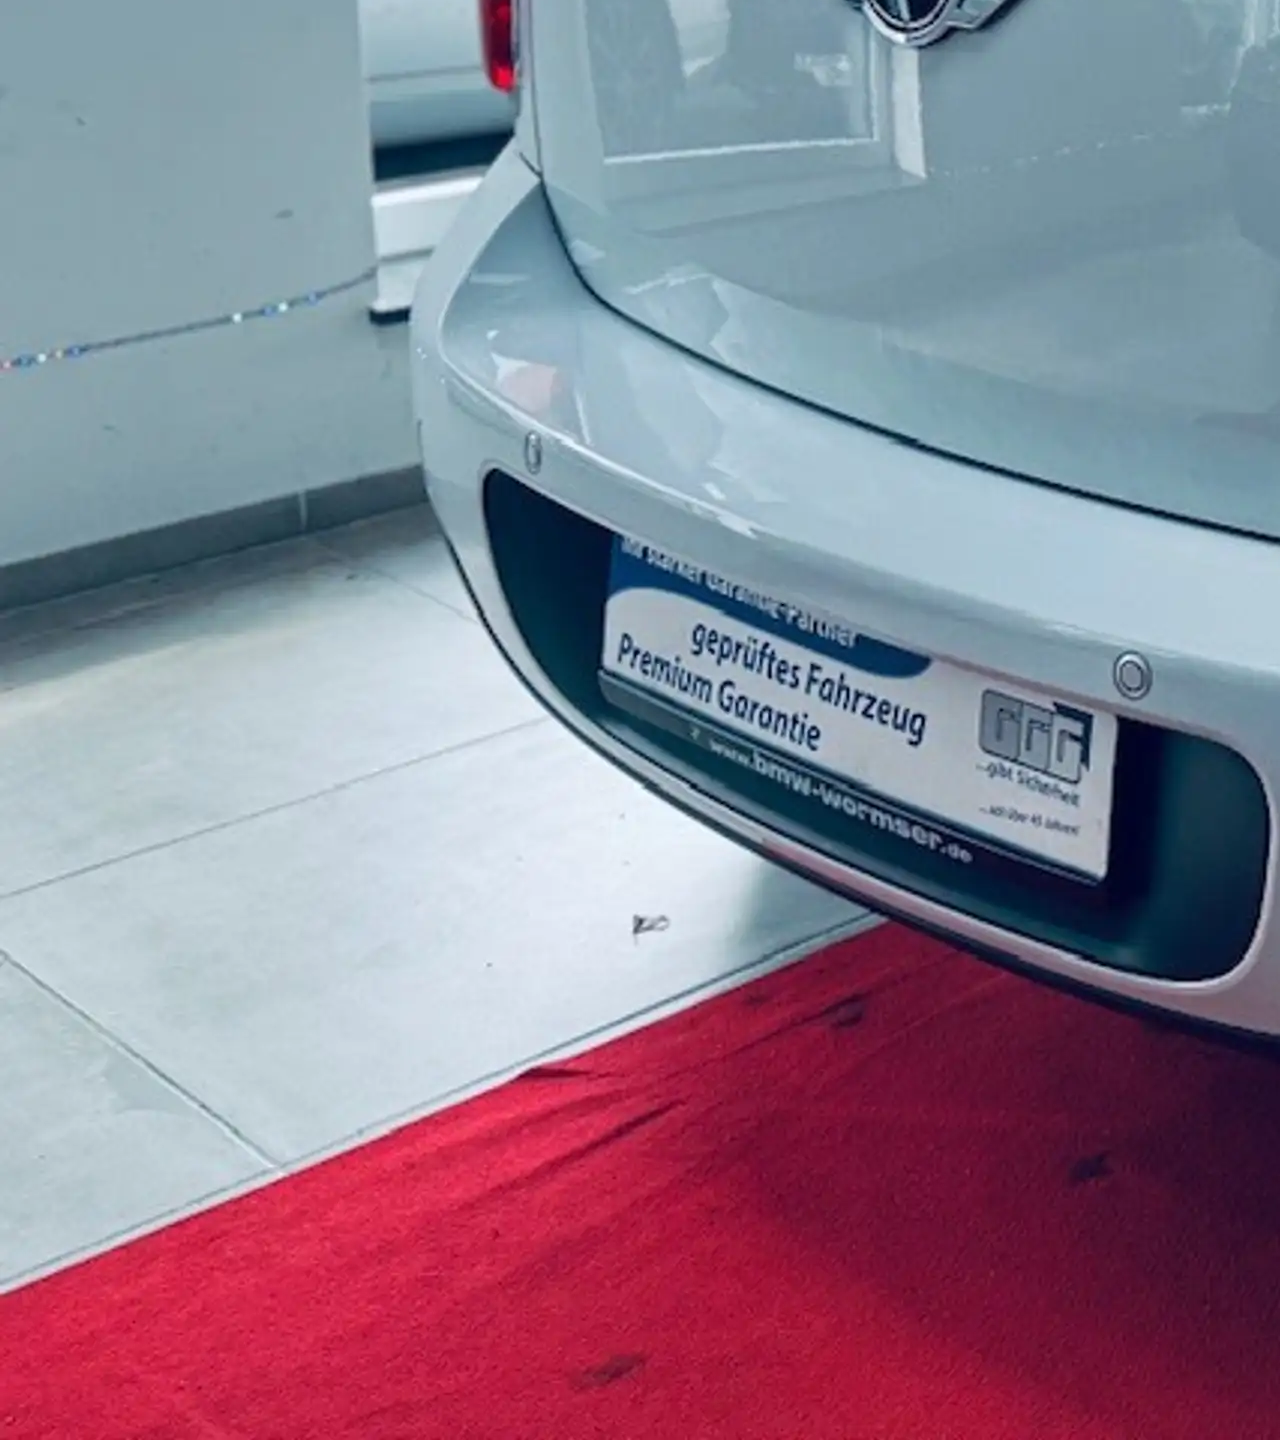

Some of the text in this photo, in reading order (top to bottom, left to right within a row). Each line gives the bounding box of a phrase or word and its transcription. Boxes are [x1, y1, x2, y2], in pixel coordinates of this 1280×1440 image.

[617, 632, 822, 752] Premium Garantie
[691, 621, 928, 747] geprüftes Fahrzeug
[709, 739, 974, 864] www.bmw-wormser.de
